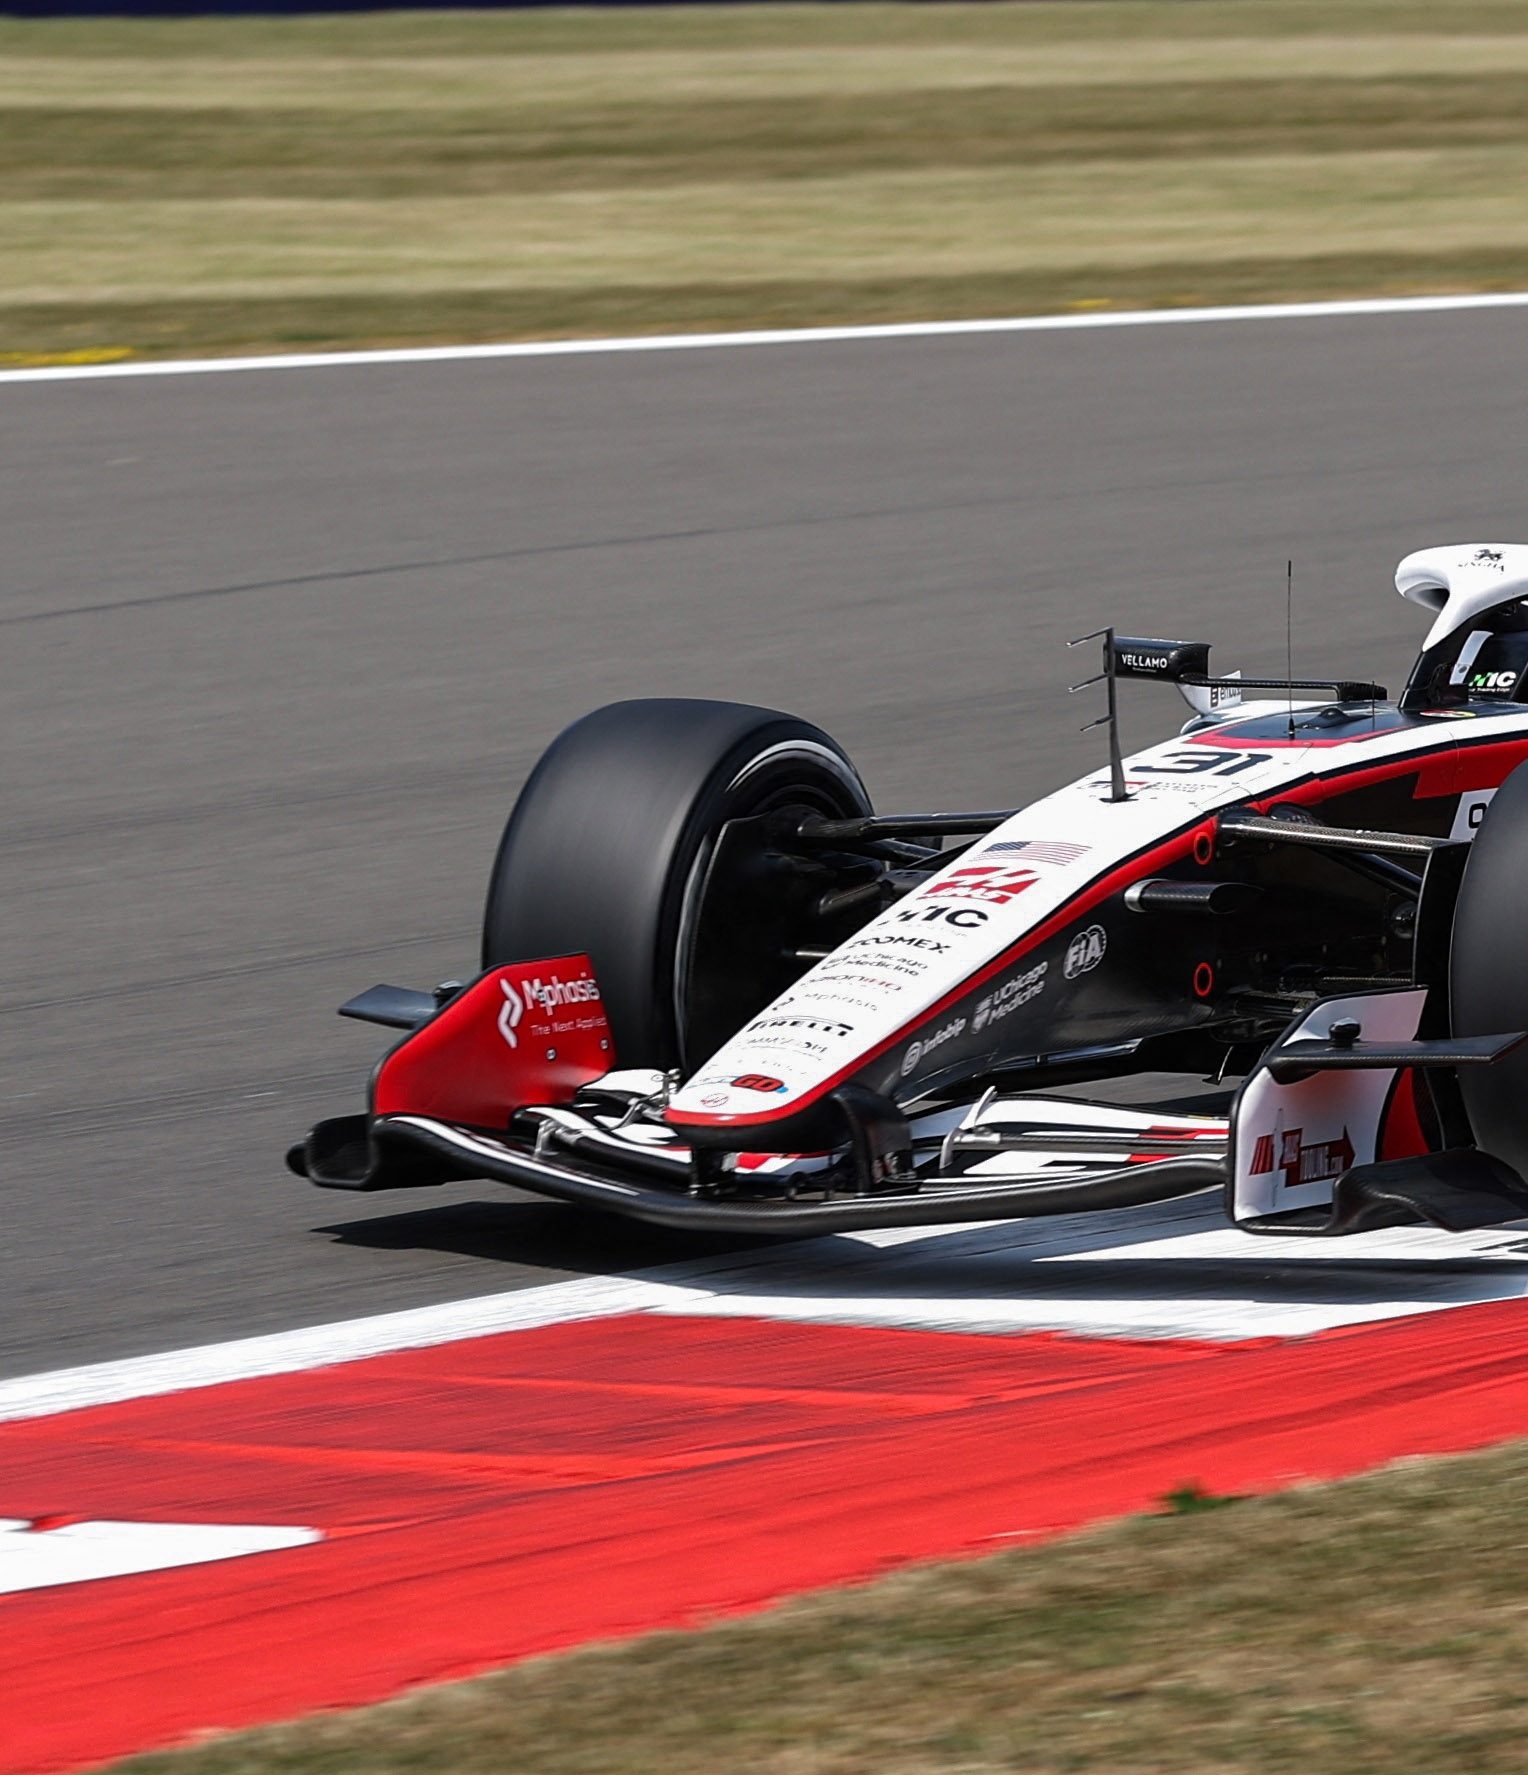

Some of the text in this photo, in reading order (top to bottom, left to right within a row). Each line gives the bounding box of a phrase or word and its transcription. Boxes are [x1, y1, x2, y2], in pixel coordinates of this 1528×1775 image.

[1121, 653, 1168, 669] VELLAMO
[1129, 751, 1274, 776] 31
[521, 972, 600, 1016] Mphasis
[988, 981, 1046, 1026] Medicine
[993, 961, 1049, 1005] UChicago
[923, 1017, 966, 1055] infobip
